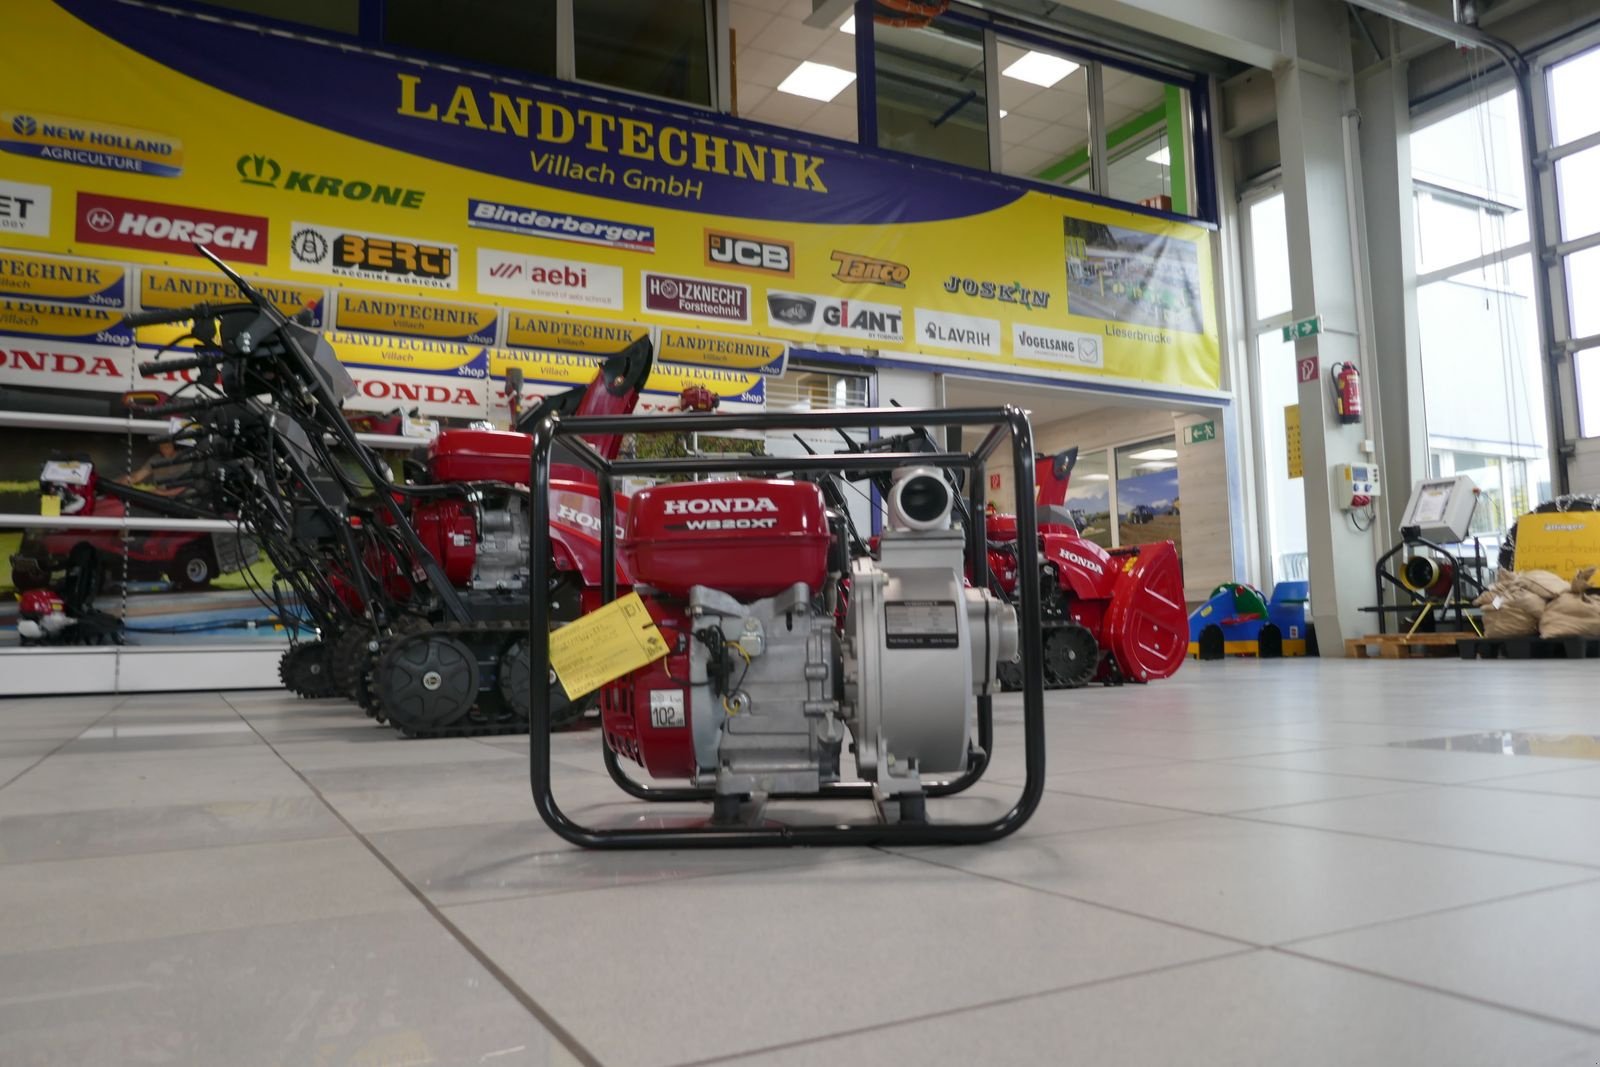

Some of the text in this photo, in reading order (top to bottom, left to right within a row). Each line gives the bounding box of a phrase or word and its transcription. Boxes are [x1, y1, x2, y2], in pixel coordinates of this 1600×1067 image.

[43, 124, 172, 155] NEW HOLLAND
[397, 73, 828, 193] LANDTECHNIK
[41, 146, 143, 171] AGRICULTURE
[530, 151, 704, 200] Villach GmbH
[284, 170, 425, 209] KRONE
[118, 212, 258, 250] HORSCH
[474, 202, 650, 242] Binderberger
[711, 238, 788, 270] JCB
[532, 266, 587, 288] aebi
[831, 250, 910, 283] Tanco
[332, 268, 451, 289] MACCHINE AGRICOLE
[88, 294, 122, 307] Shop
[650, 279, 743, 306] HOLZKNECHT
[944, 276, 1049, 309] JOSKIN
[344, 298, 480, 326] LANDTECHNIK
[679, 299, 741, 317] Forsttechnik
[96, 331, 130, 346] Shop
[467, 333, 493, 345] Shop
[514, 317, 633, 342] LANDTECHNIK
[938, 325, 990, 347] LAVRIH
[666, 334, 771, 358] LANDTECHNIK
[1018, 331, 1075, 352] VOGELSANG
[381, 351, 414, 362] Villach
[458, 366, 485, 378] Shop
[540, 366, 569, 377] Villach
[652, 363, 750, 384] ANDTECHNIK
[741, 392, 762, 403] Shop
[664, 497, 779, 515] HONDA
[1059, 547, 1104, 575] HONDA
[653, 706, 675, 726] 102
